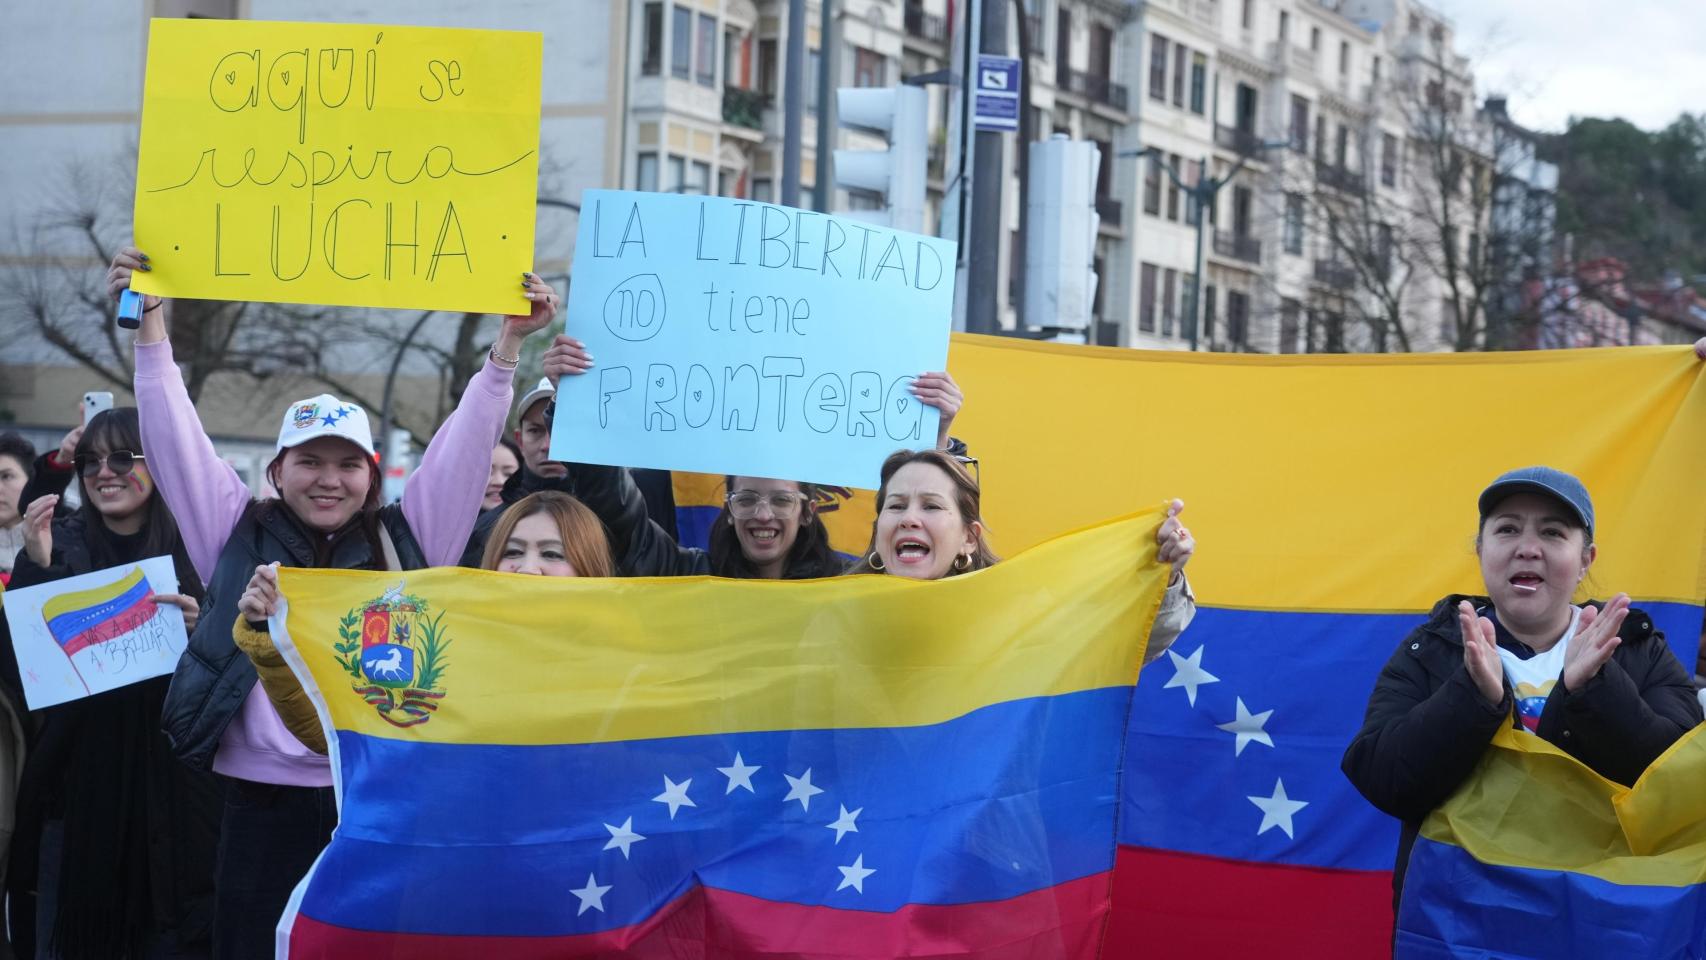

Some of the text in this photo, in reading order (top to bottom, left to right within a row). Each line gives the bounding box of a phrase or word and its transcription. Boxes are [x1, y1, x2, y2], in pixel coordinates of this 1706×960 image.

[420, 60, 464, 101] se
[147, 145, 535, 201] respira
[214, 199, 472, 281] LUCHA
[593, 199, 943, 290] LA LIBERTAD
[618, 281, 811, 335] no tiene
[105, 627, 177, 674] BRILLAR
[113, 619, 123, 636] A
